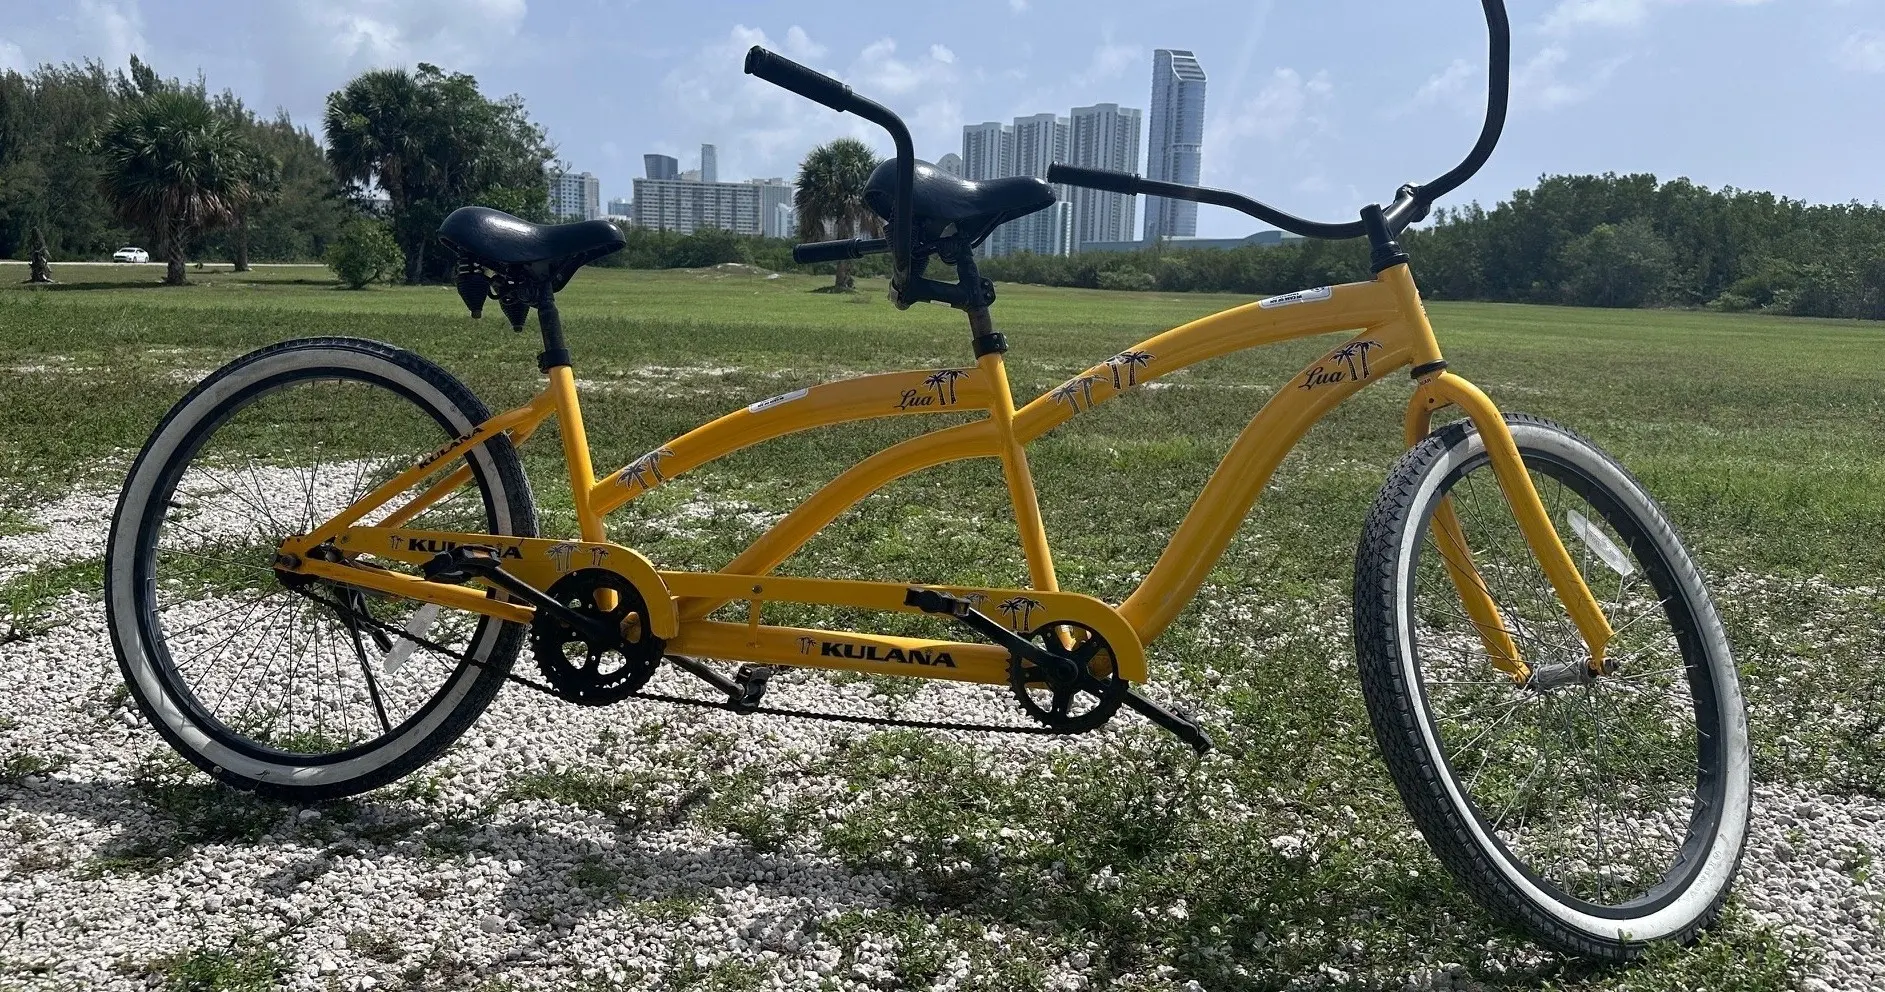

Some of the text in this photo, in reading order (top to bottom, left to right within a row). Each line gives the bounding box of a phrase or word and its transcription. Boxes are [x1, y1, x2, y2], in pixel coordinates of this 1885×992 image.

[1298, 366, 1346, 390] Lua
[893, 389, 935, 410] Lua
[419, 427, 485, 469] KULANA
[408, 538, 523, 559] KULA
[821, 641, 957, 668] KULANA
